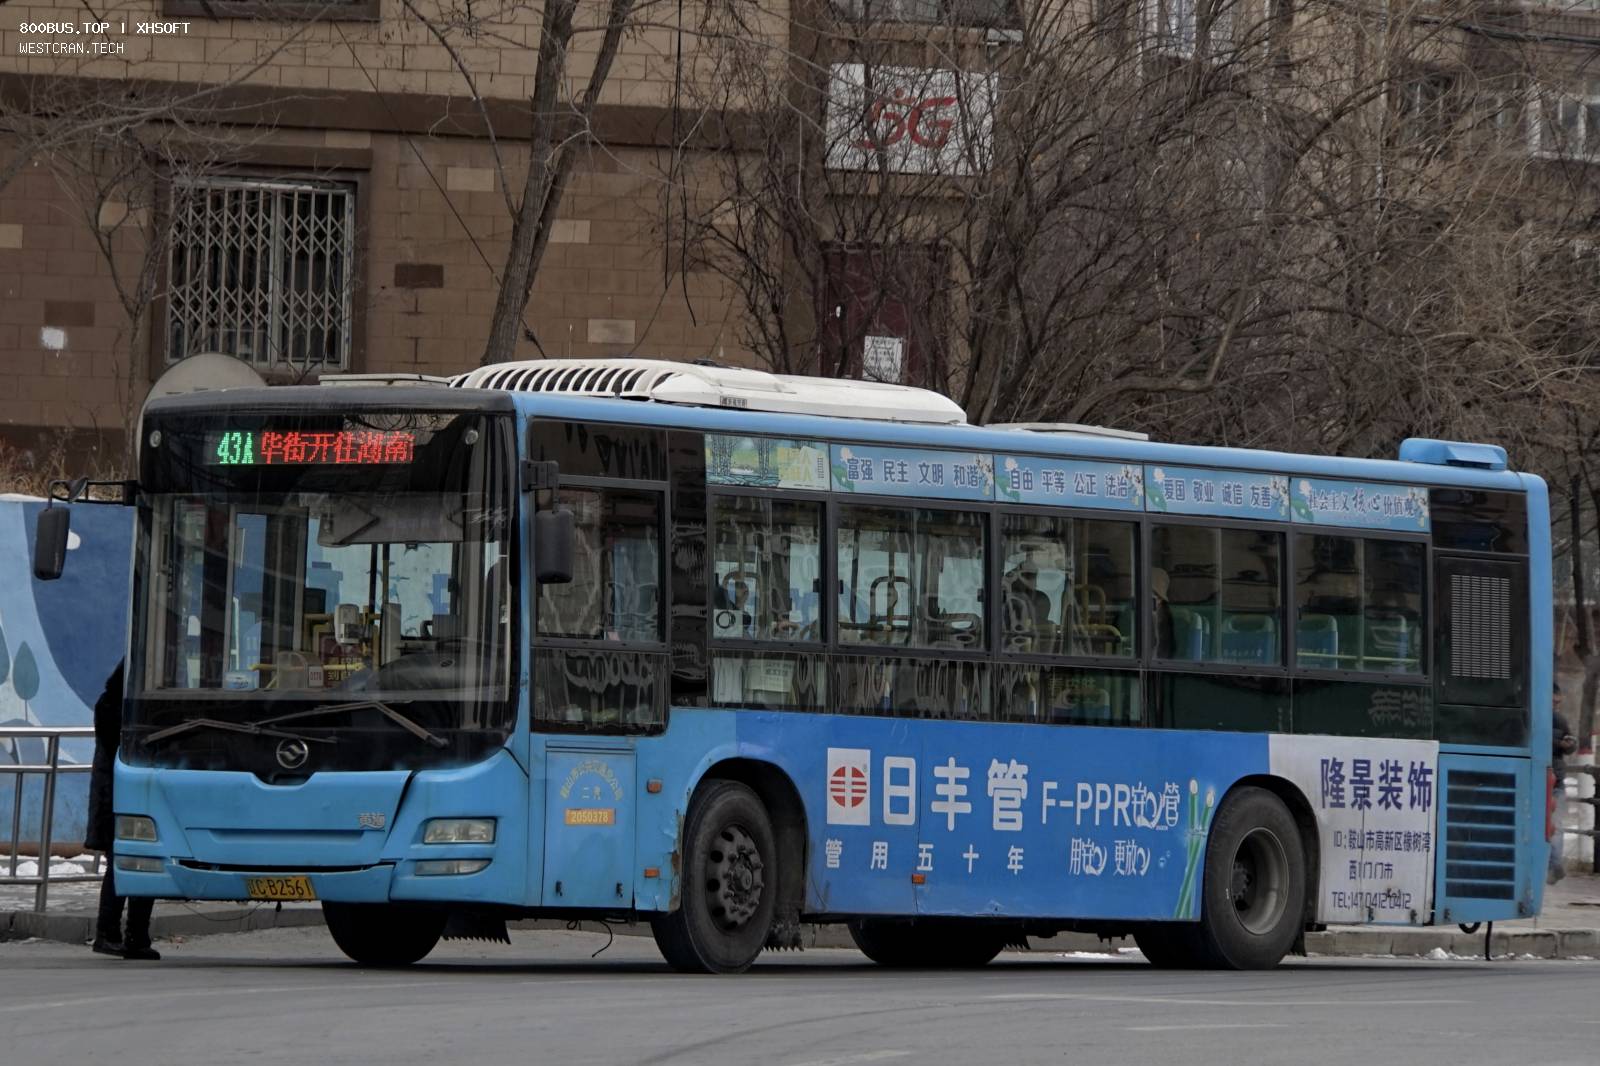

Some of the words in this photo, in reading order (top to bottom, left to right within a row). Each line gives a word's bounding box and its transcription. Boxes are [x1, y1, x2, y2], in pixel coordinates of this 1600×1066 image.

[217, 432, 254, 464] 43A
[847, 457, 874, 482] 富强
[883, 460, 909, 484] 民主
[918, 462, 944, 486] 文明
[953, 463, 980, 488] 和谐
[1010, 468, 1033, 491] 自由
[1042, 470, 1065, 494] 平等
[1074, 472, 1097, 496] 公正
[1105, 473, 1128, 498] 法治
[1164, 479, 1185, 501] 爱国
[1193, 480, 1214, 503] 敬业
[1222, 482, 1243, 506] 诚信
[1250, 484, 1271, 508] 友善
[883, 756, 1029, 831] 日丰管
[1320, 757, 1433, 813] 隆景装饰
[571, 811, 609, 824] 2050378
